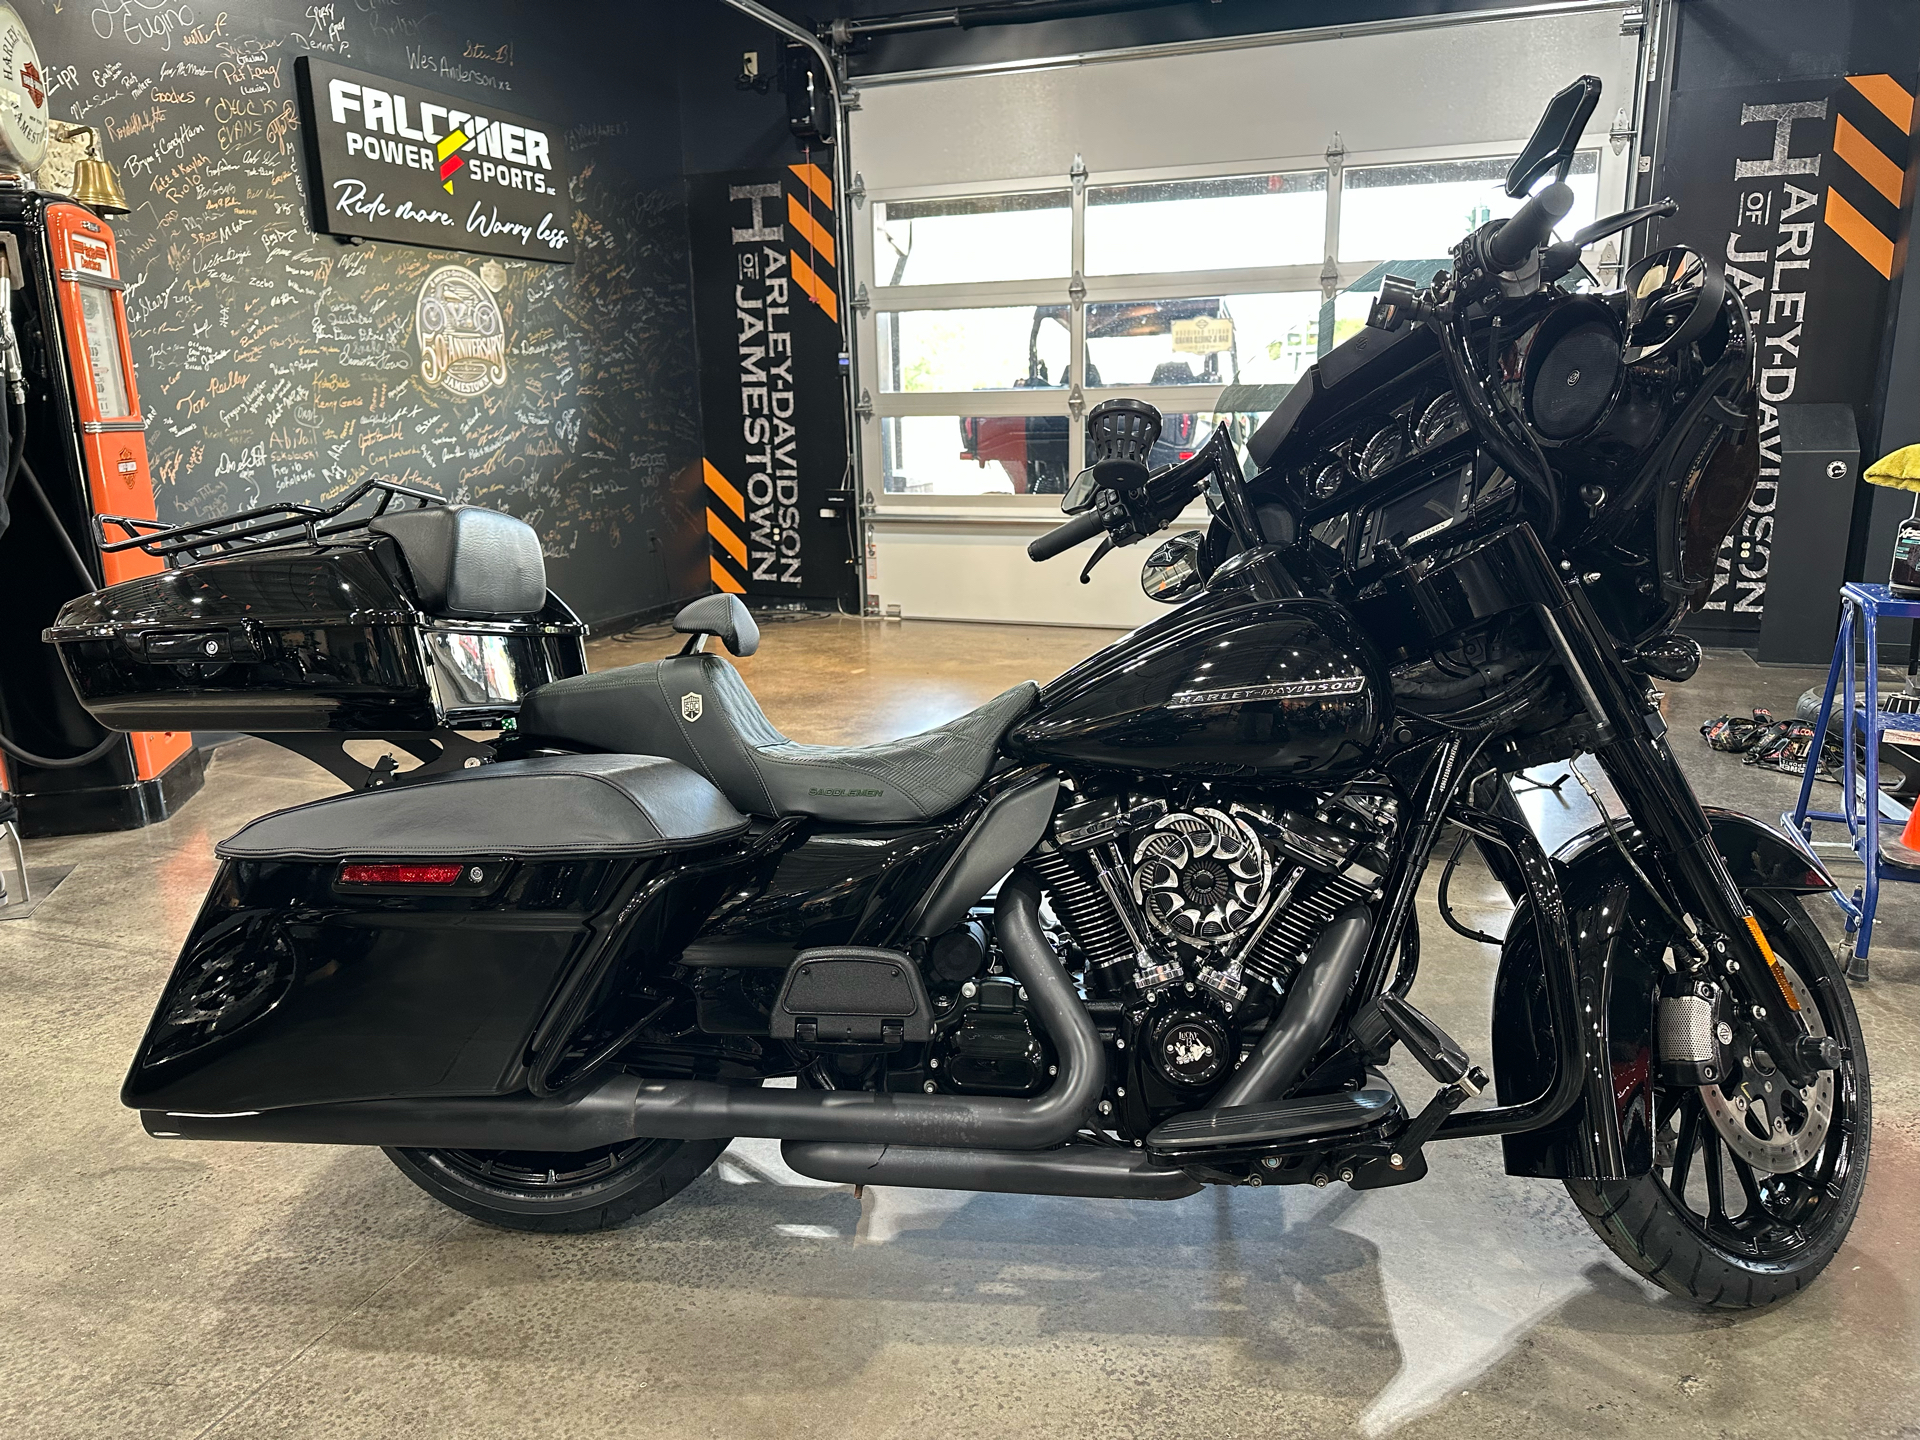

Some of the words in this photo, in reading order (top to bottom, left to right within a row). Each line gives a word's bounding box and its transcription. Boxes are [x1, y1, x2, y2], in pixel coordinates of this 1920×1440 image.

[406, 45, 437, 70] Wes
[328, 78, 552, 170] FALCONER
[346, 132, 434, 172] POWER
[468, 158, 546, 194] SPORTS
[333, 179, 390, 222] Ride
[466, 200, 532, 245] Worry
[1745, 192, 1765, 225] OF
[742, 253, 755, 279] OF
[444, 374, 490, 393] JAMESTOWN
[735, 284, 777, 581] JAMESTOWN
[1179, 682, 1357, 704] HARLEY-DAVIDSON
[808, 786, 884, 797] SADDLEMEN
